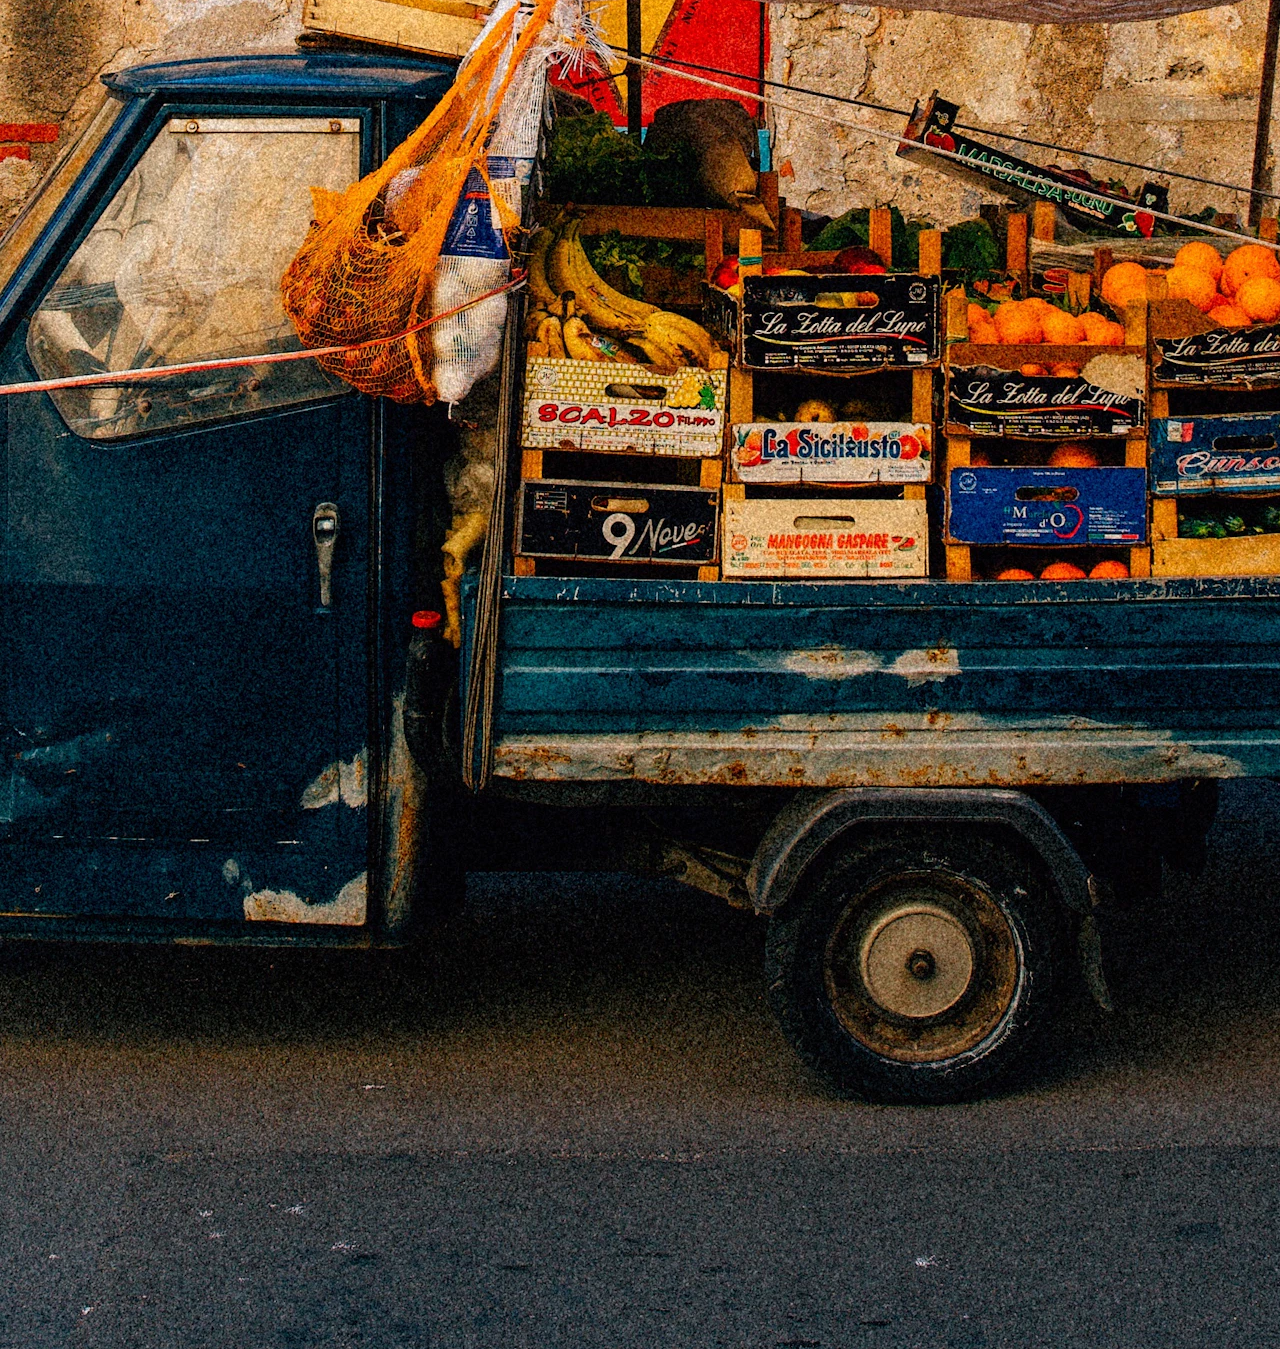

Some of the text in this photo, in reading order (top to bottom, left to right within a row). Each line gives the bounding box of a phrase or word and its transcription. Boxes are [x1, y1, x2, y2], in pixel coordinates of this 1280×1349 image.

[754, 311, 788, 335] La
[845, 312, 882, 334] del
[875, 310, 927, 339] Lupo
[1165, 336, 1197, 357] La
[960, 381, 993, 405] La
[1051, 383, 1088, 405] del
[537, 403, 676, 428] SCALZO
[761, 428, 790, 460] La
[602, 513, 703, 559] 9 Nove
[836, 533, 889, 549] GASPARE
